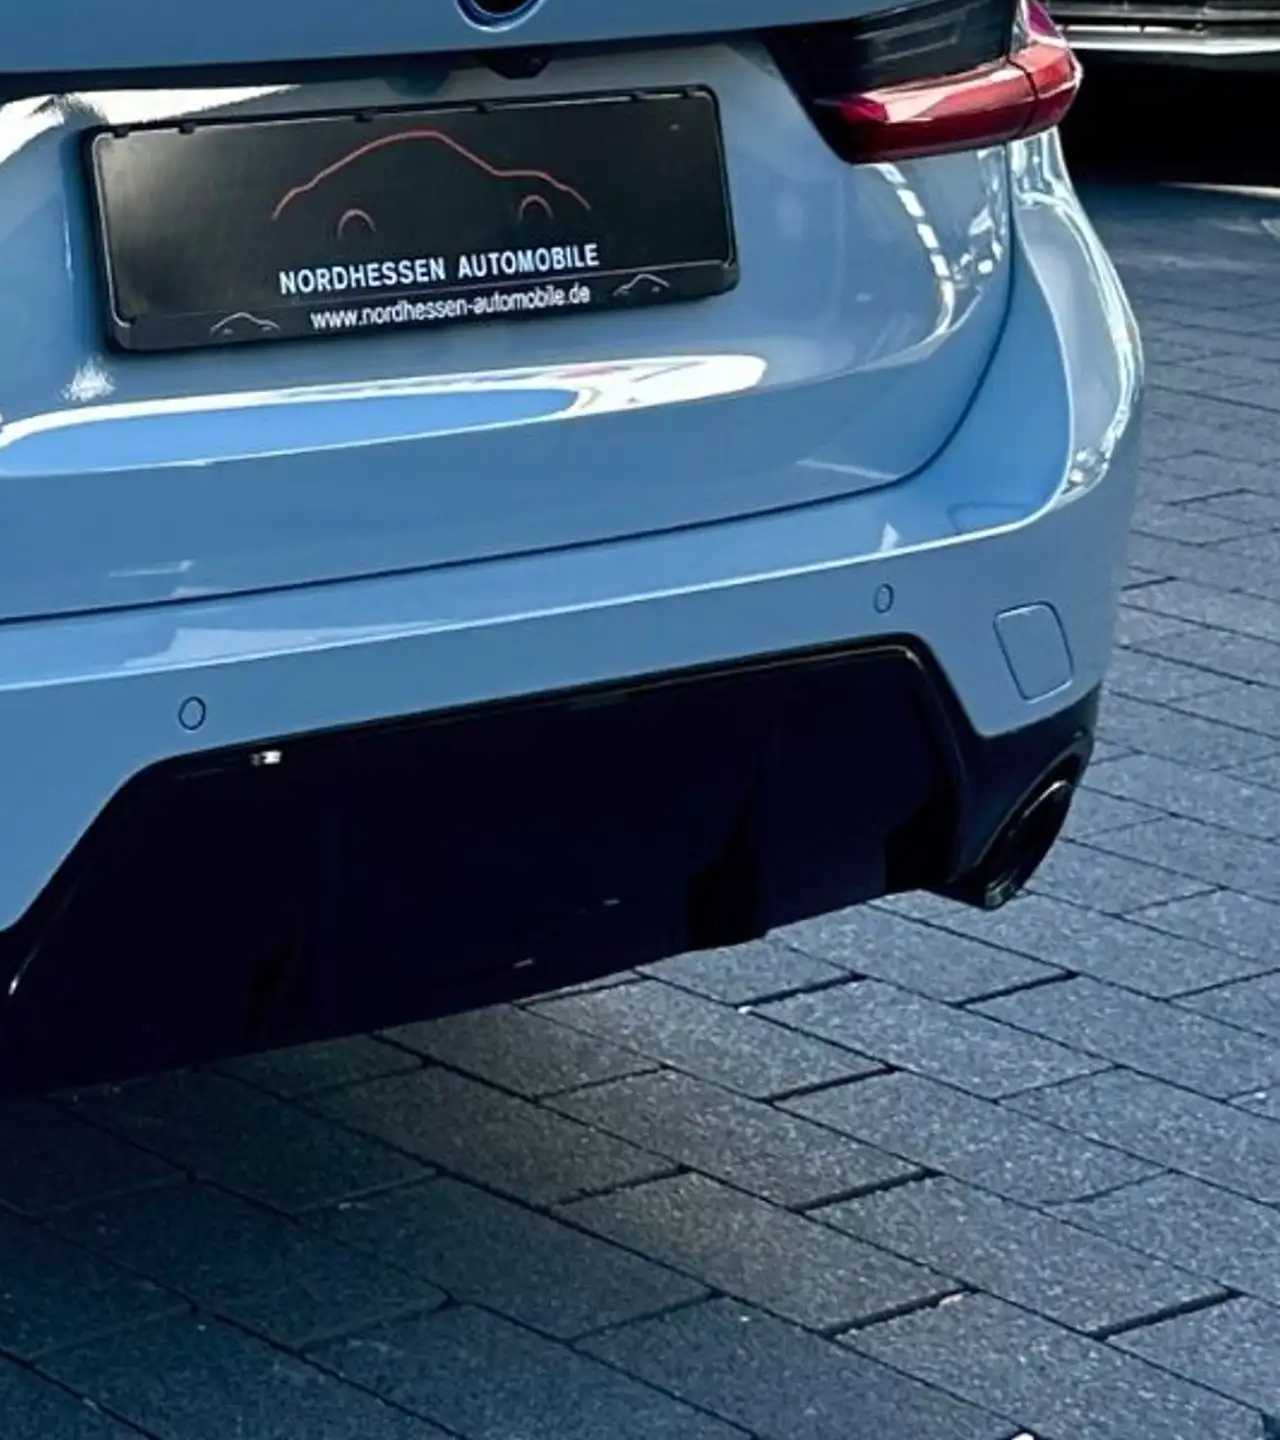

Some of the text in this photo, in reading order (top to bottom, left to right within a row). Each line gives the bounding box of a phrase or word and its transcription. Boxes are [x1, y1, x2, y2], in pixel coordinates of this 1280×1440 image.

[278, 242, 600, 295] NORDHESSEN AUTOMOBILE
[310, 281, 591, 330] www.nordhessen-automobile.de
